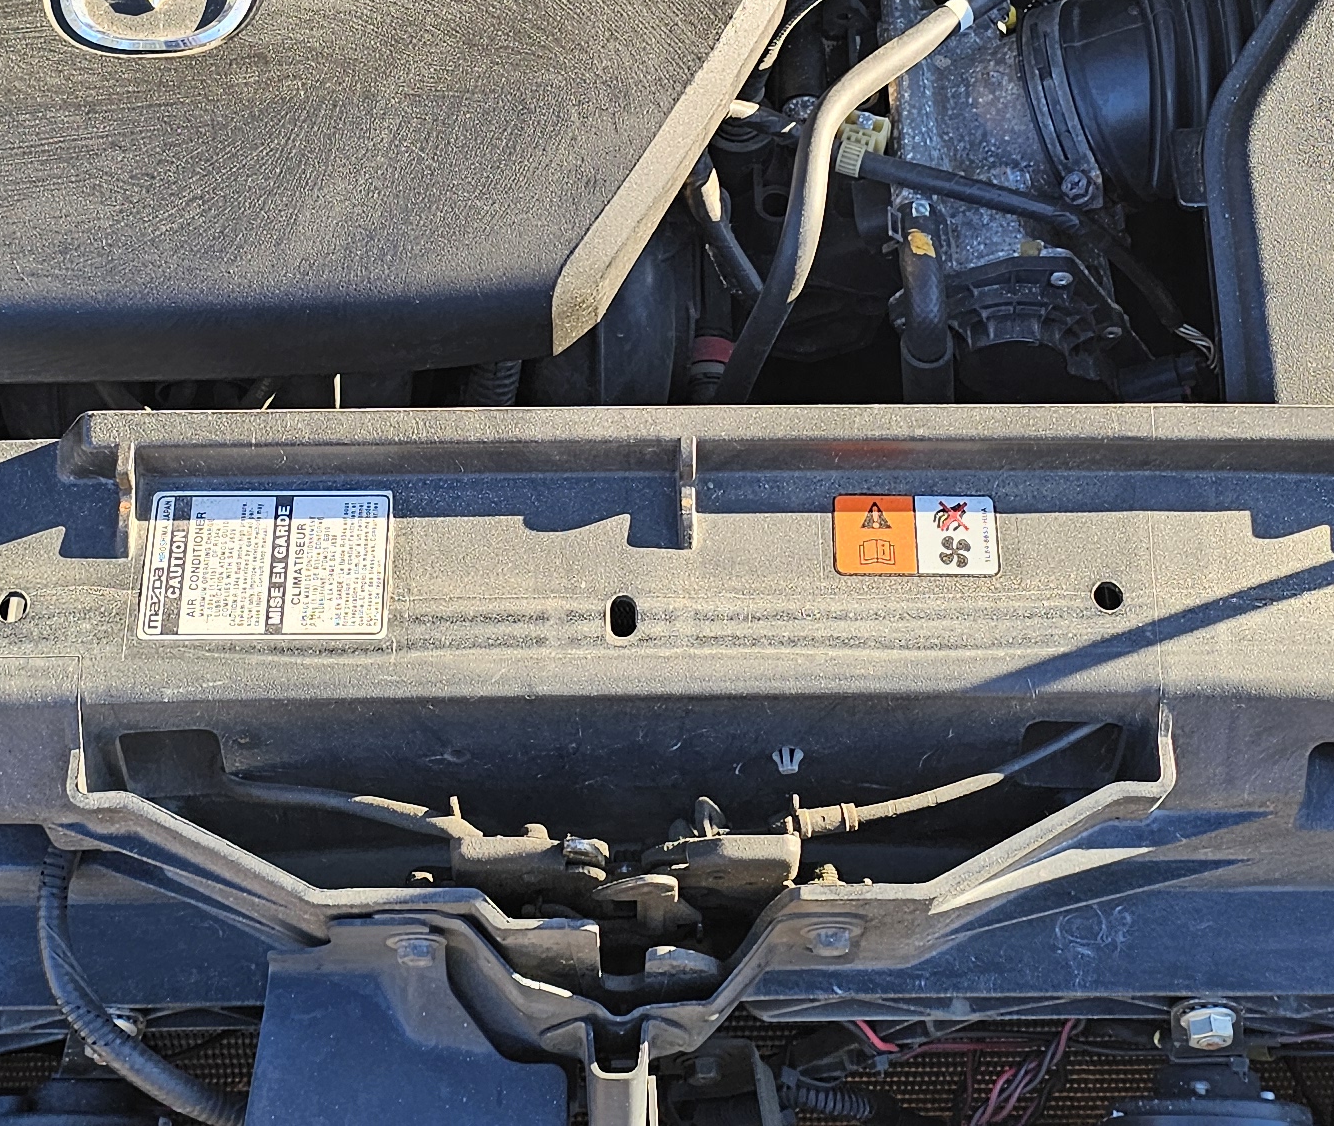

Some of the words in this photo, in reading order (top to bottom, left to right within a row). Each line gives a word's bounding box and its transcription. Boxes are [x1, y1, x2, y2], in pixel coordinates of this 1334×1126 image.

[162, 500, 172, 520] JAPAN
[273, 505, 290, 558] GARDE
[167, 530, 186, 598] CAUTION
[188, 511, 206, 590] CONDITIONER
[271, 562, 285, 582] EN
[290, 523, 306, 605] CLIMATISEUR
[147, 566, 163, 629] mazda
[186, 598, 197, 617] AIR
[267, 587, 284, 625] MISE
